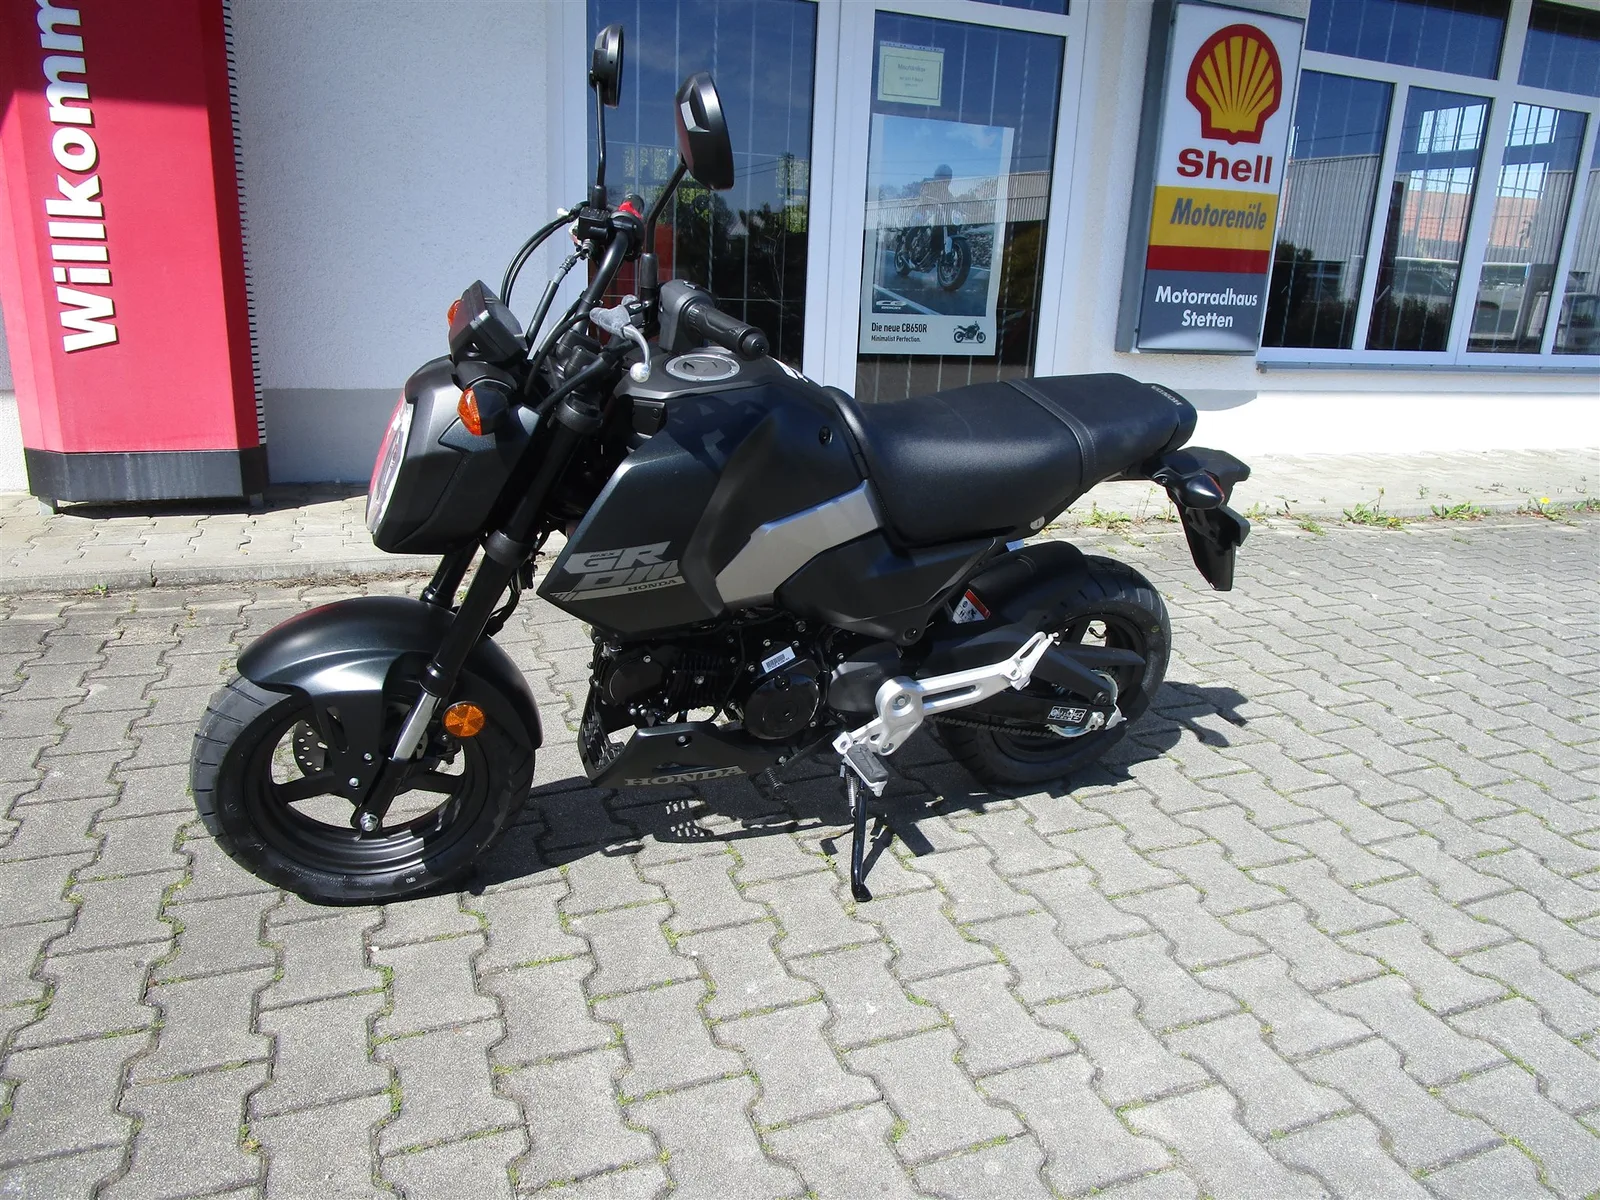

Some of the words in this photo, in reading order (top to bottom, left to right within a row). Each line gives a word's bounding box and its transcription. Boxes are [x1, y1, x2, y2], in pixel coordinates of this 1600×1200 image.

[1176, 148, 1273, 184] Shell
[1170, 197, 1267, 230] Motorenöle
[1155, 285, 1258, 306] Motorradhaus
[871, 322, 883, 332] Die
[884, 324, 901, 333] neue
[901, 322, 928, 333] CB650R
[1181, 309, 1234, 328] Stetten
[871, 334, 896, 342] Minimalist
[627, 578, 678, 592] HONDA
[624, 765, 747, 787] HONDA
